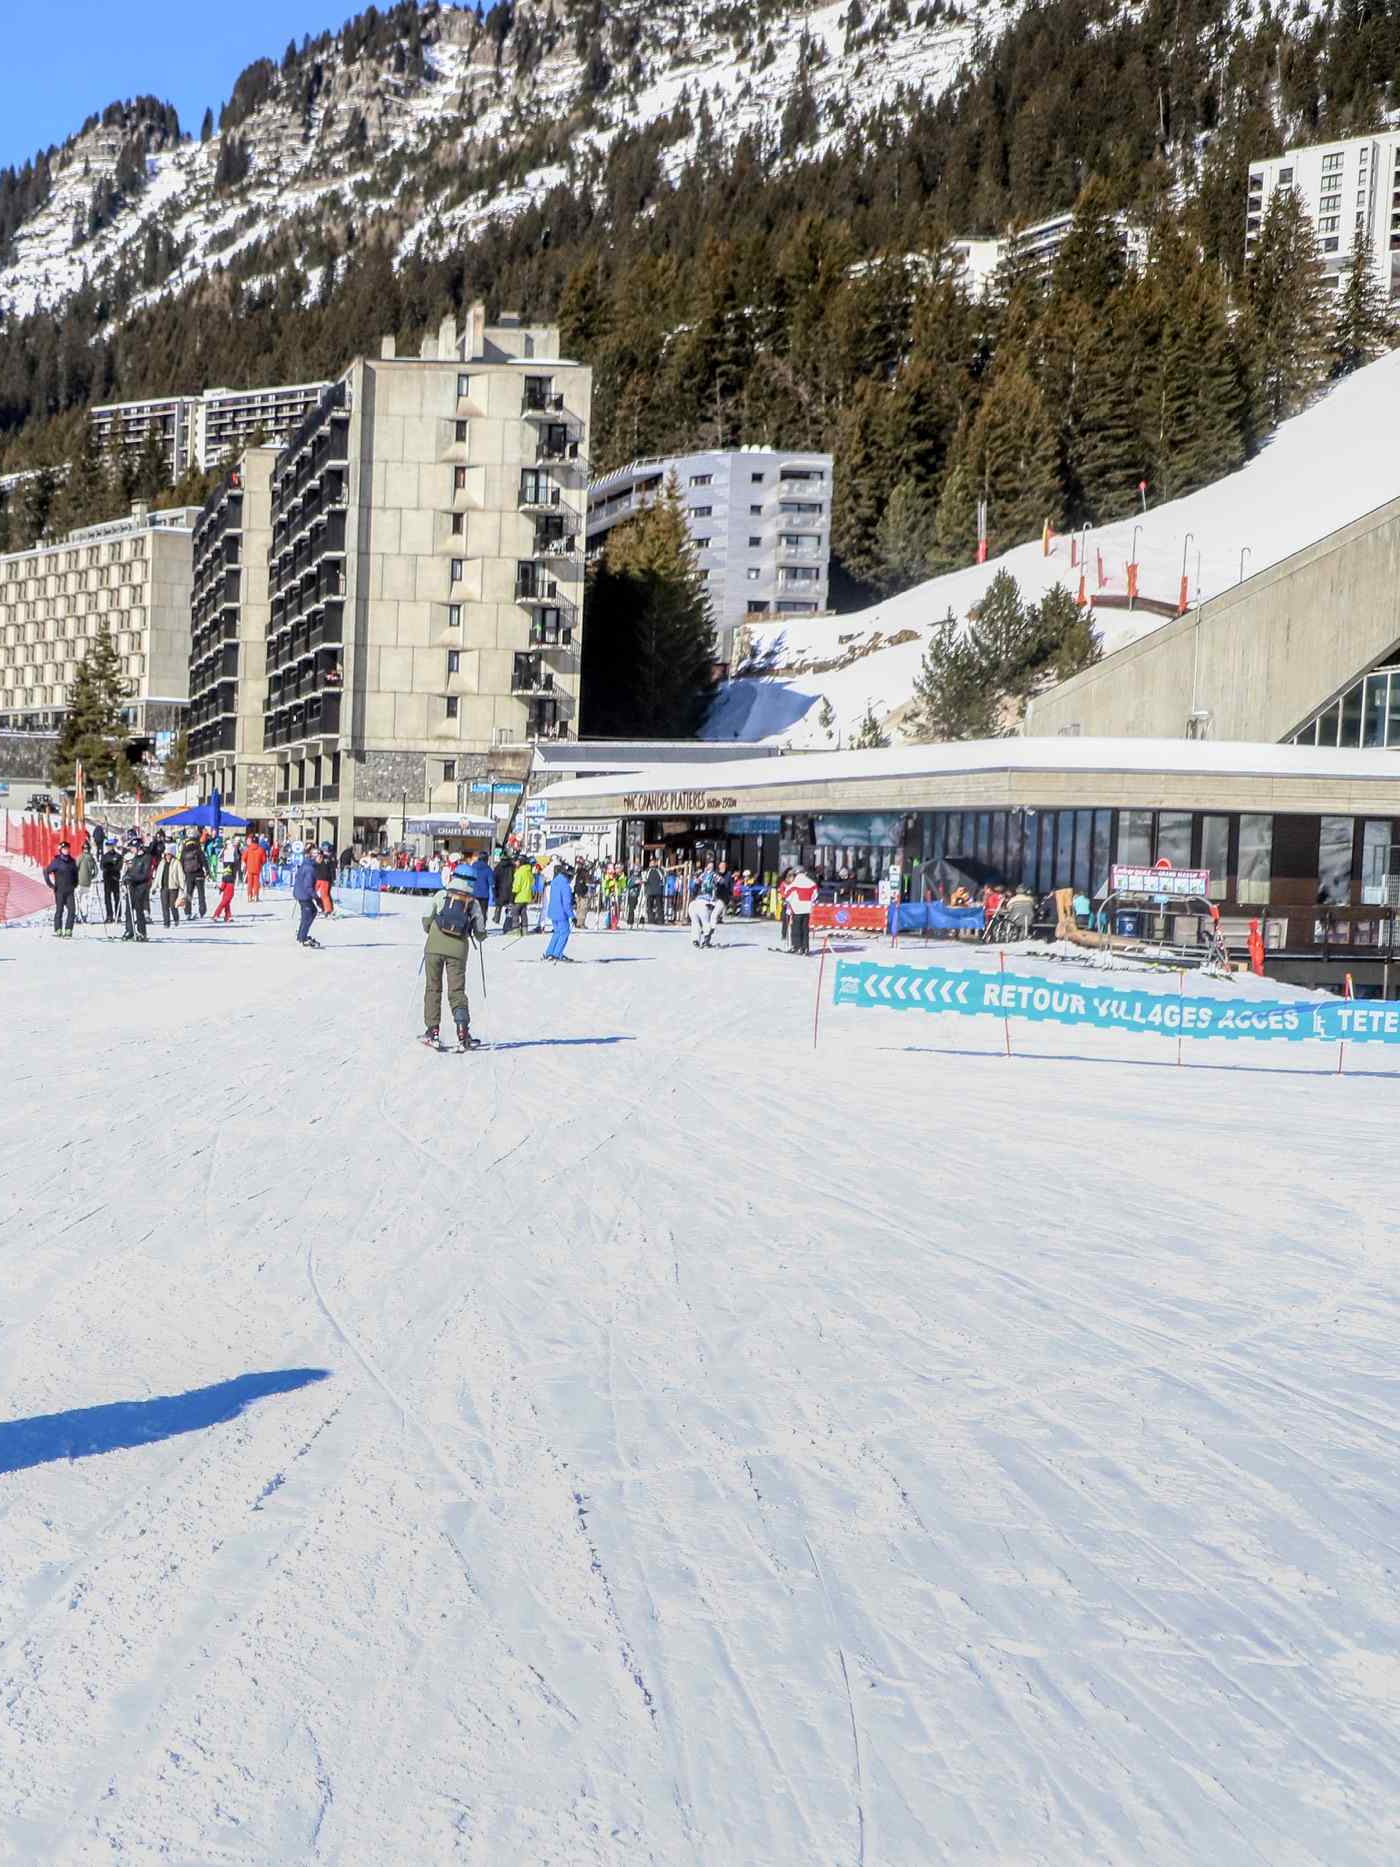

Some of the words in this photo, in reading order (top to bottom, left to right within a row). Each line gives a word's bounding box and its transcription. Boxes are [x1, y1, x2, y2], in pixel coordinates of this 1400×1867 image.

[983, 983, 1087, 1015] RETOUR
[1217, 1007, 1299, 1030] ACCES
[1336, 1009, 1399, 1033] TETE
